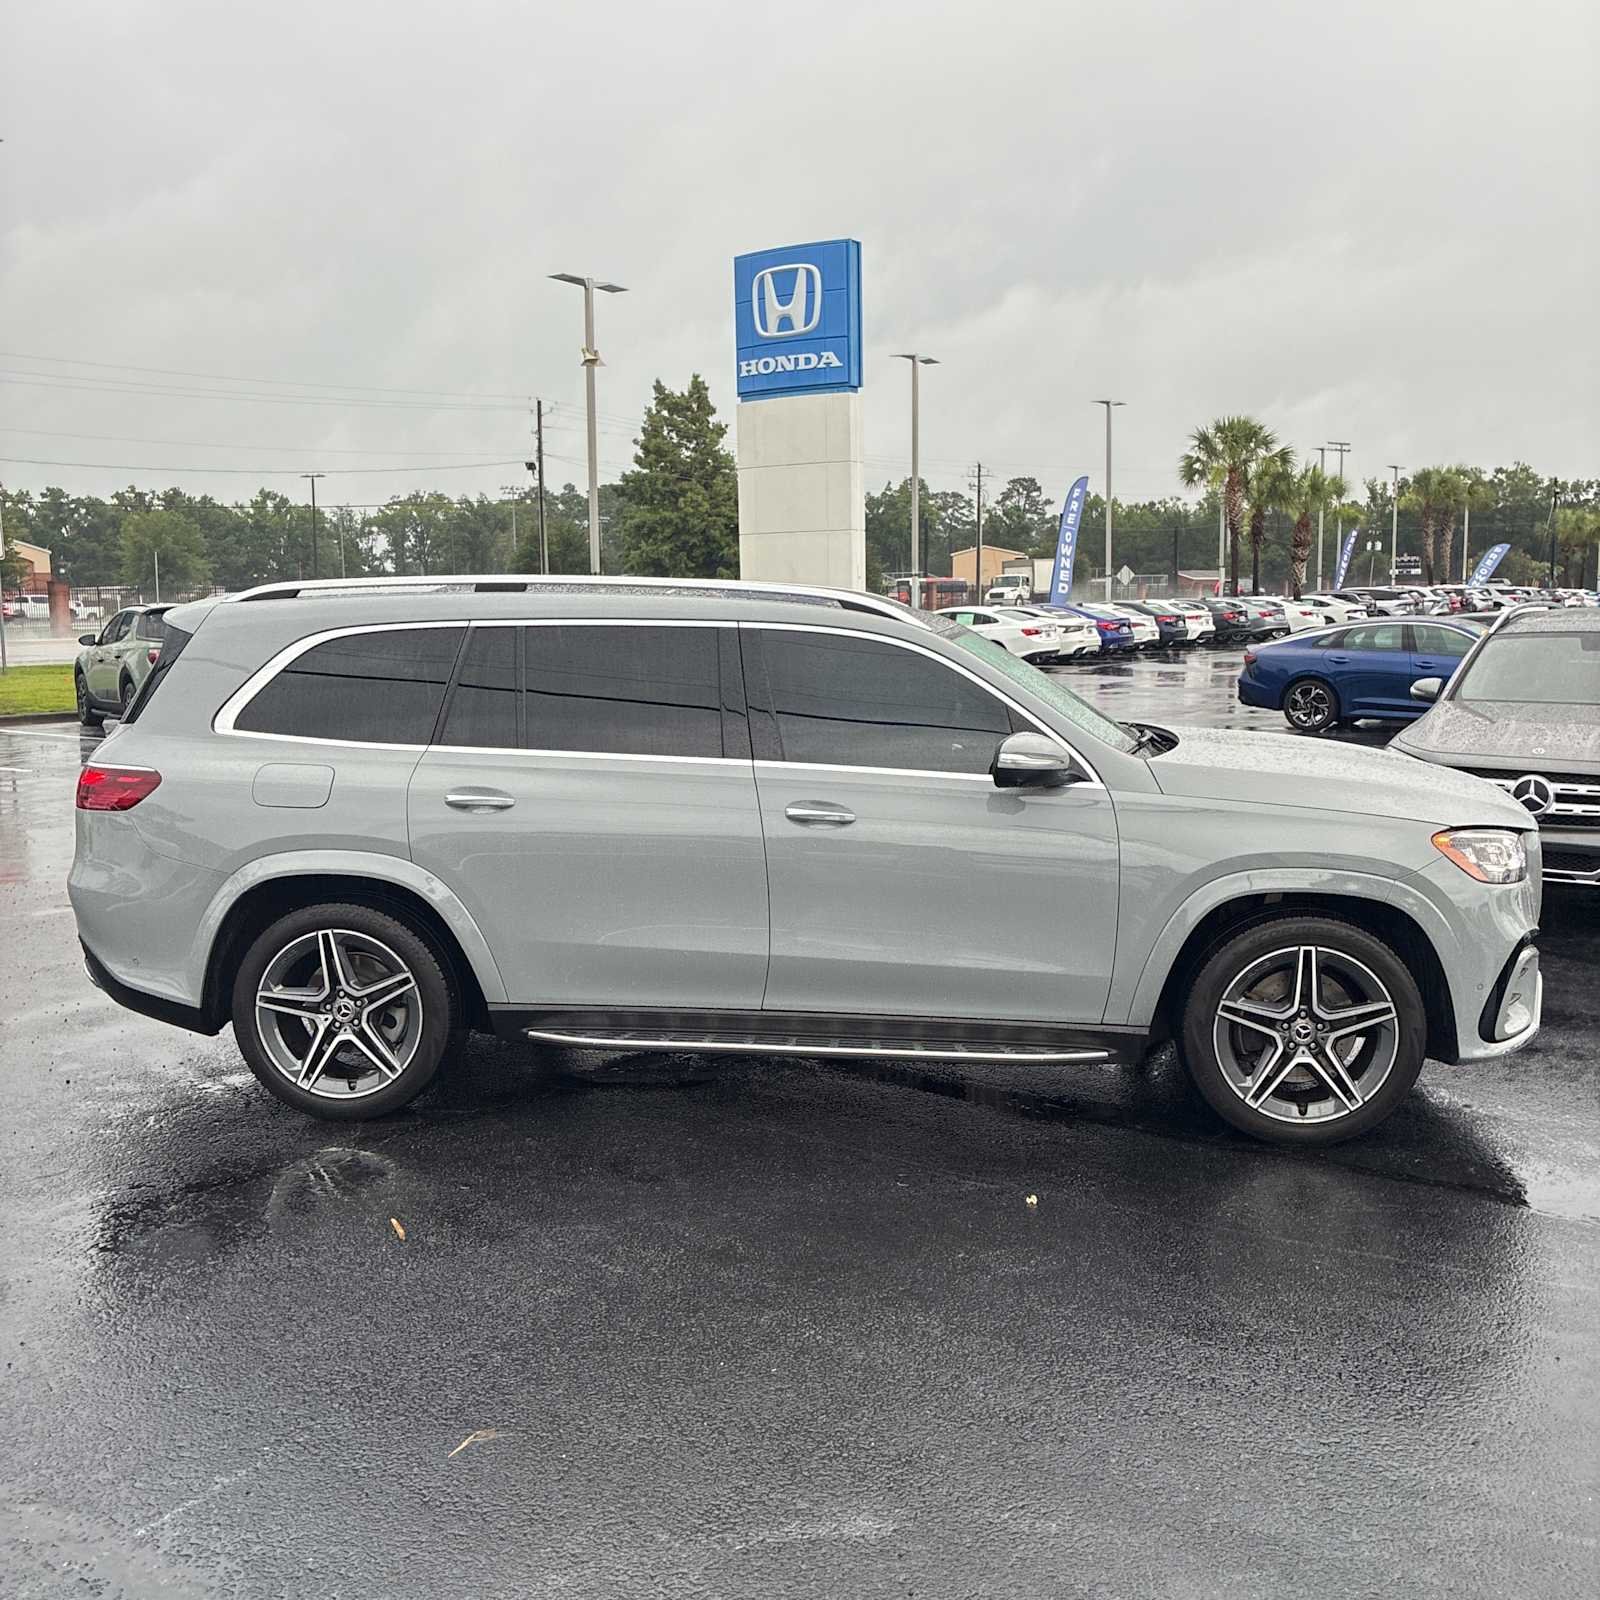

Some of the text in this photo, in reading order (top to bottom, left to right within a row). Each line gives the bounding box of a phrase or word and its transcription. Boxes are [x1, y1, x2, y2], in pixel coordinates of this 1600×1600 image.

[739, 351, 843, 378] HONDA
[1057, 488, 1082, 594] PRE OWNED
